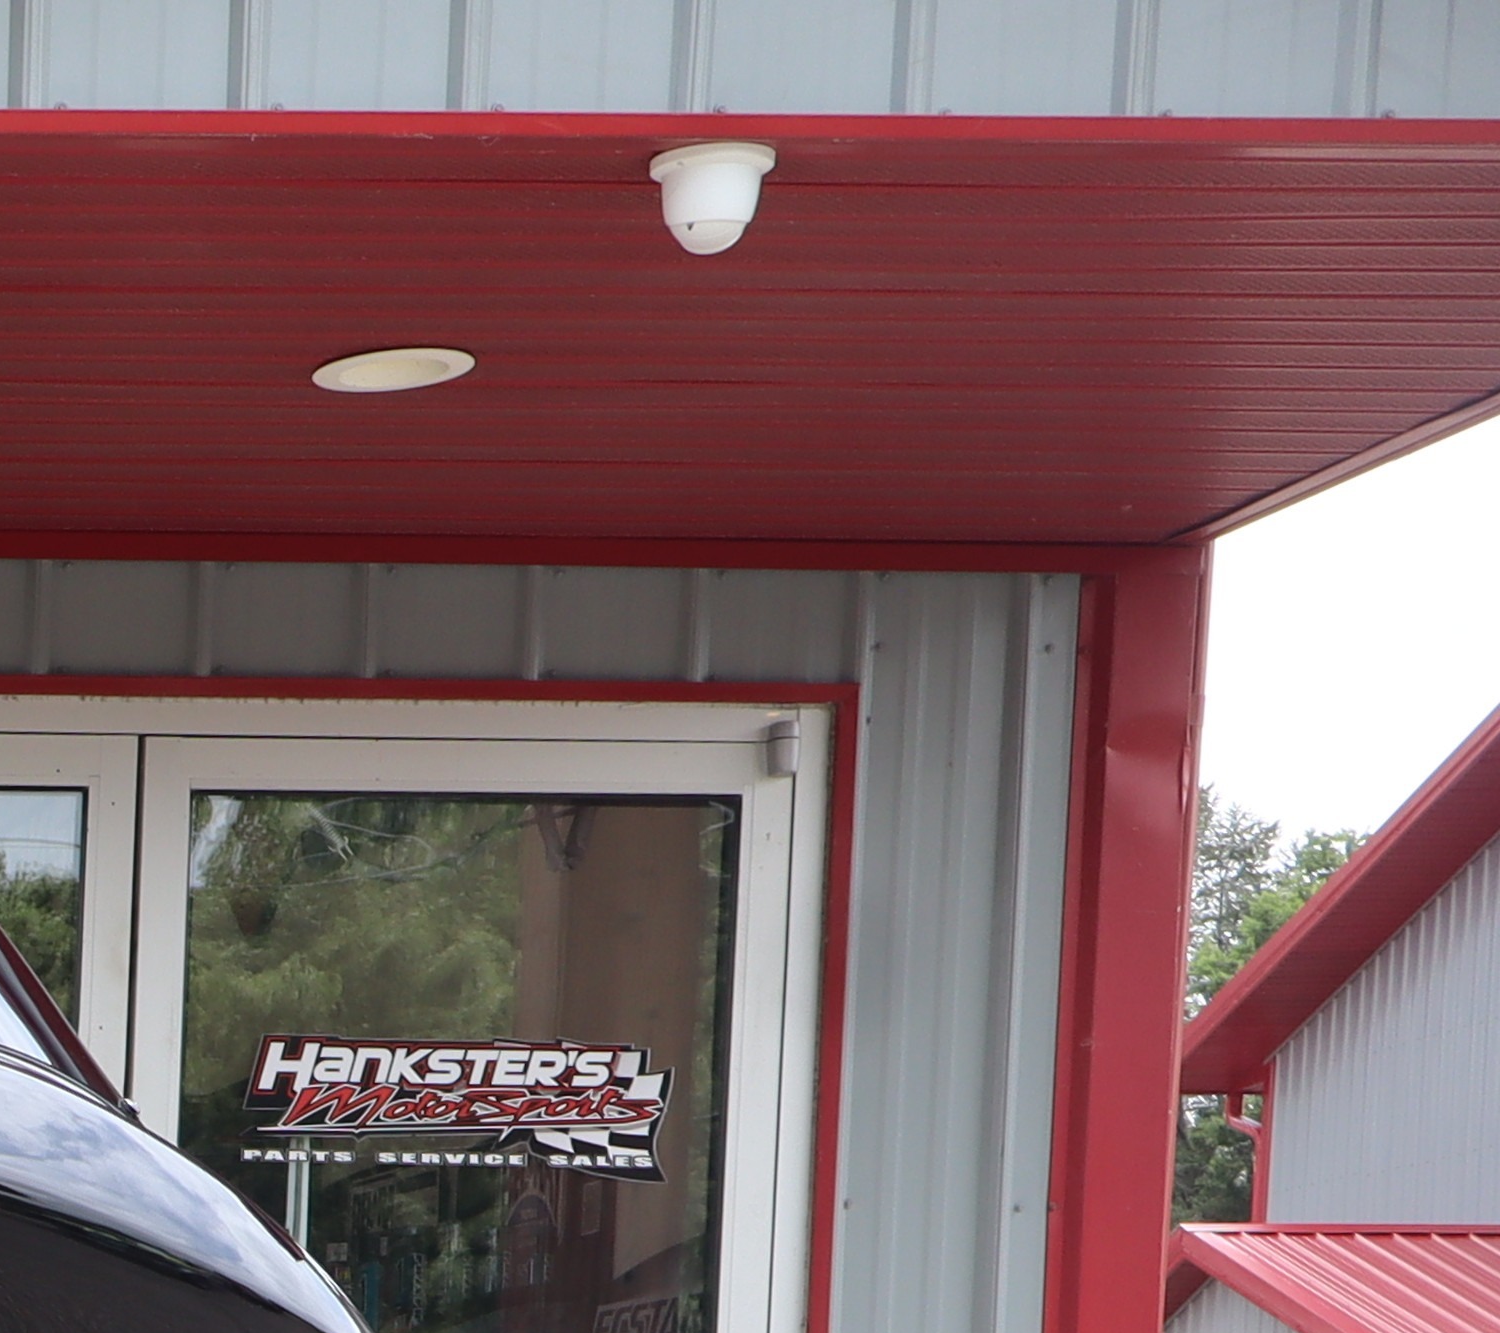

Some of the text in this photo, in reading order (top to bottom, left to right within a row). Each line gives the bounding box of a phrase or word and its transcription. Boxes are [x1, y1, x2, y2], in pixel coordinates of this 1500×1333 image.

[240, 1147, 655, 1169] PARTS SERVICE SALES
